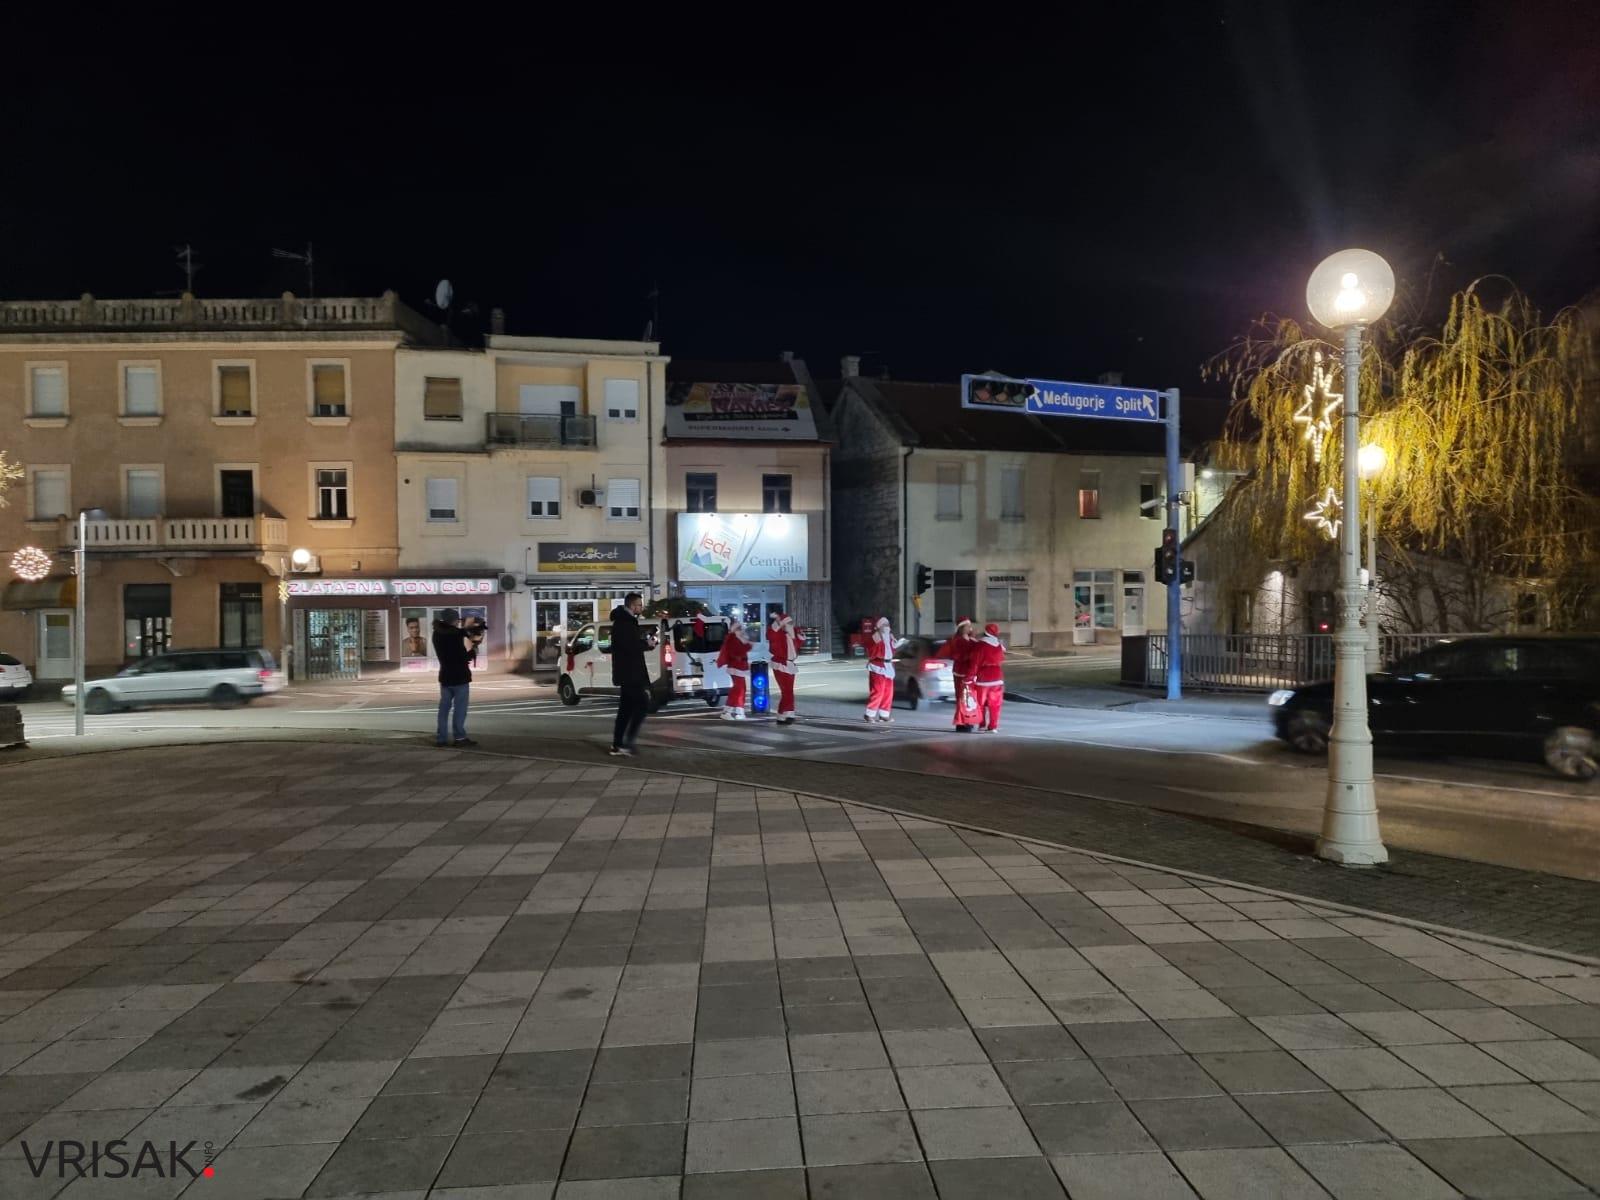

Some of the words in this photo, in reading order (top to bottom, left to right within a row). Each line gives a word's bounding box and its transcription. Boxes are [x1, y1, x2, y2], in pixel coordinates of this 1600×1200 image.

[1043, 390, 1105, 411] Međugorje
[1115, 396, 1142, 413] Split
[750, 555, 794, 567] Central
[779, 561, 803, 576] pub
[288, 581, 385, 593] ZLATARNA
[392, 581, 437, 593] TONI
[442, 581, 491, 593] GOLD
